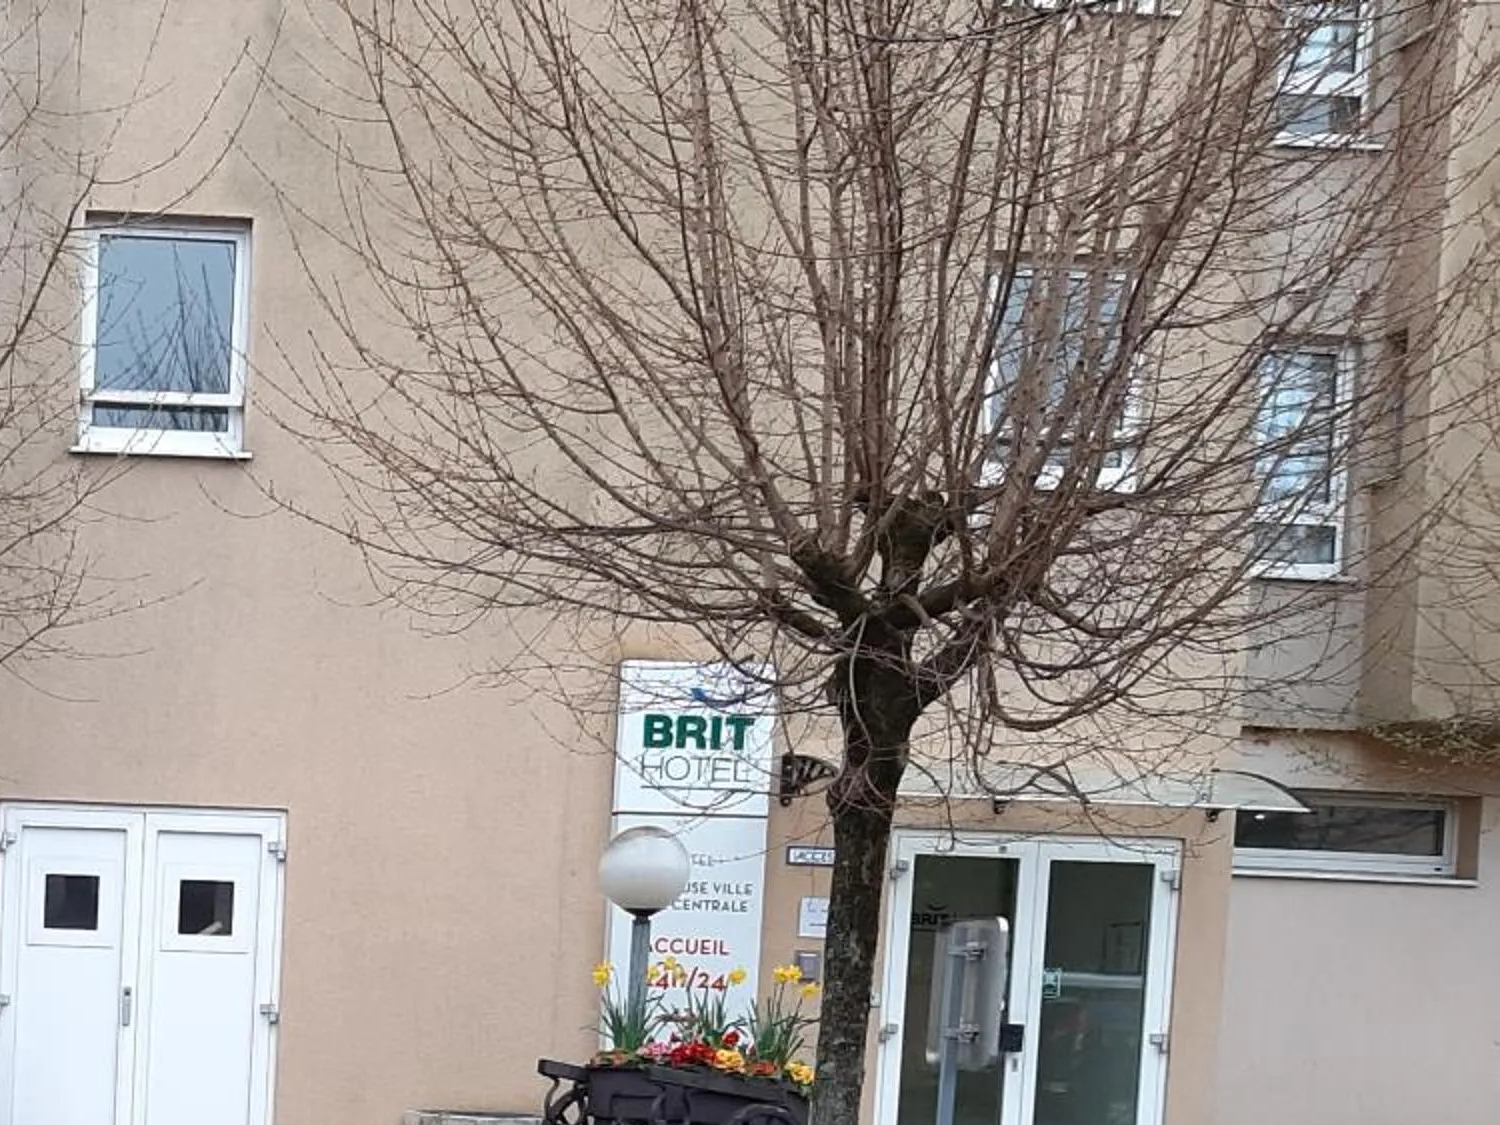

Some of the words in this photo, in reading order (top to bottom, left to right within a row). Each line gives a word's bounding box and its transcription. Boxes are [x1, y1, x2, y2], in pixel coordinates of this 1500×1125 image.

[643, 713, 756, 750] BRIT
[640, 755, 750, 782] HOTEL
[713, 883, 754, 897] VILLE
[671, 899, 748, 913] CENTRALE
